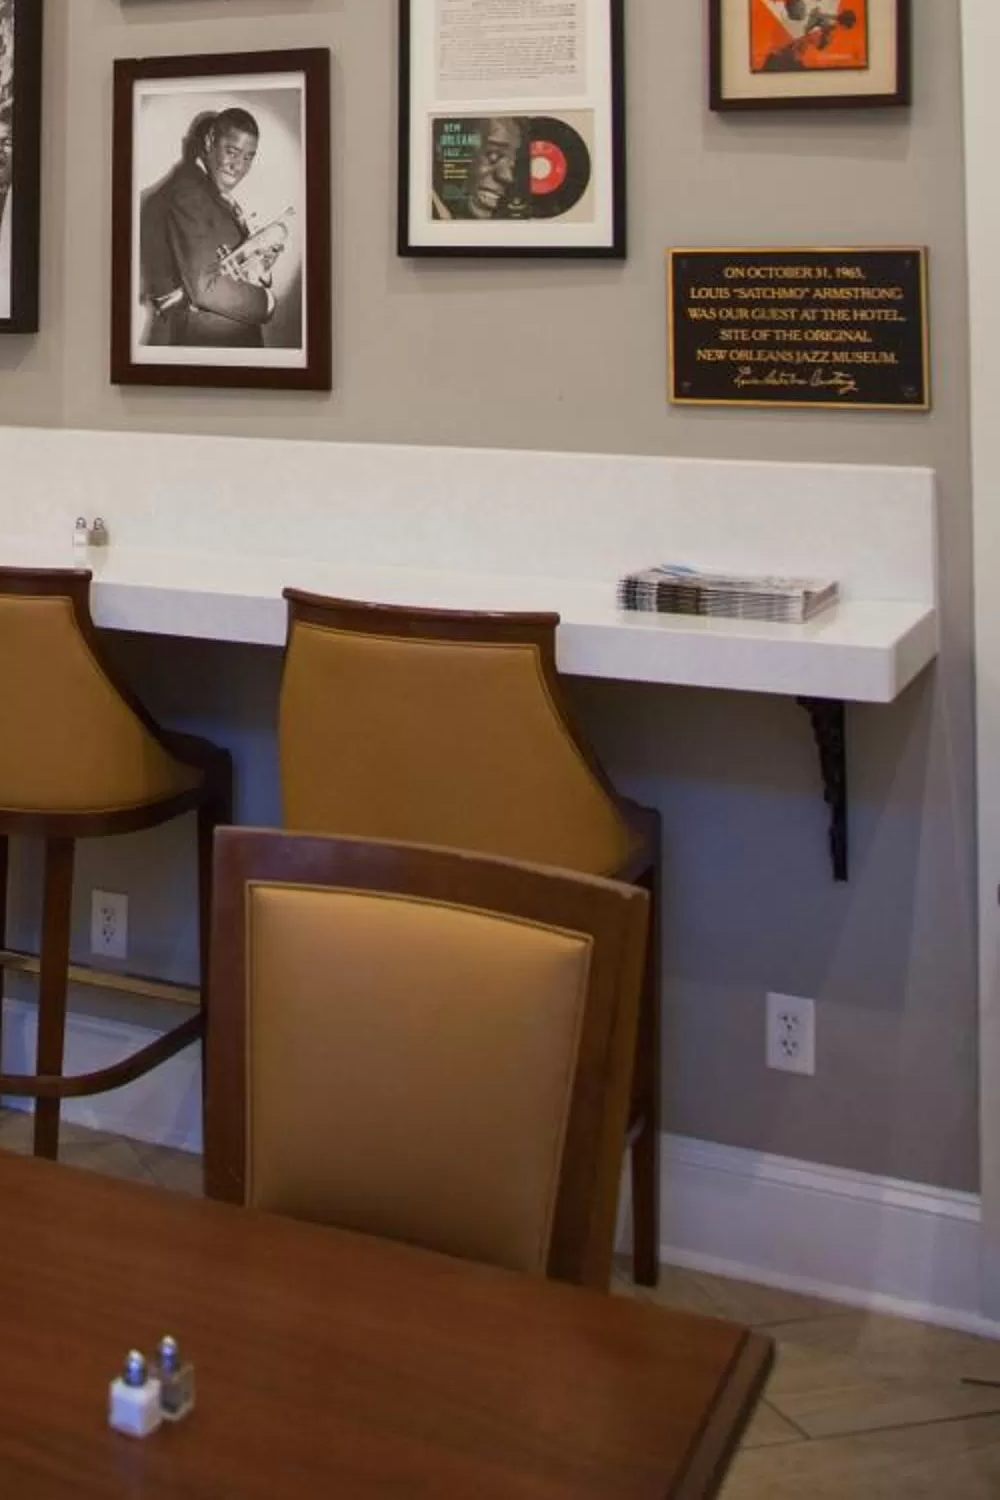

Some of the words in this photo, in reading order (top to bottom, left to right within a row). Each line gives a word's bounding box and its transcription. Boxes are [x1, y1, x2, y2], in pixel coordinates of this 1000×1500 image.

[723, 266, 745, 279] ON
[747, 266, 812, 279] OCTOBER
[690, 287, 730, 300] LOUIS
[687, 307, 716, 321] WAS
[719, 307, 750, 321] OUR
[751, 308, 800, 321] GUEST
[800, 308, 819, 321] AT
[820, 308, 851, 321] THE
[719, 328, 751, 341] SITE
[752, 328, 773, 341] OF
[774, 328, 802, 341] THE
[803, 329, 873, 342] ORIGINAL
[696, 349, 728, 361] NEW
[729, 349, 794, 363] ORLEANS
[794, 350, 831, 364] JAZZ
